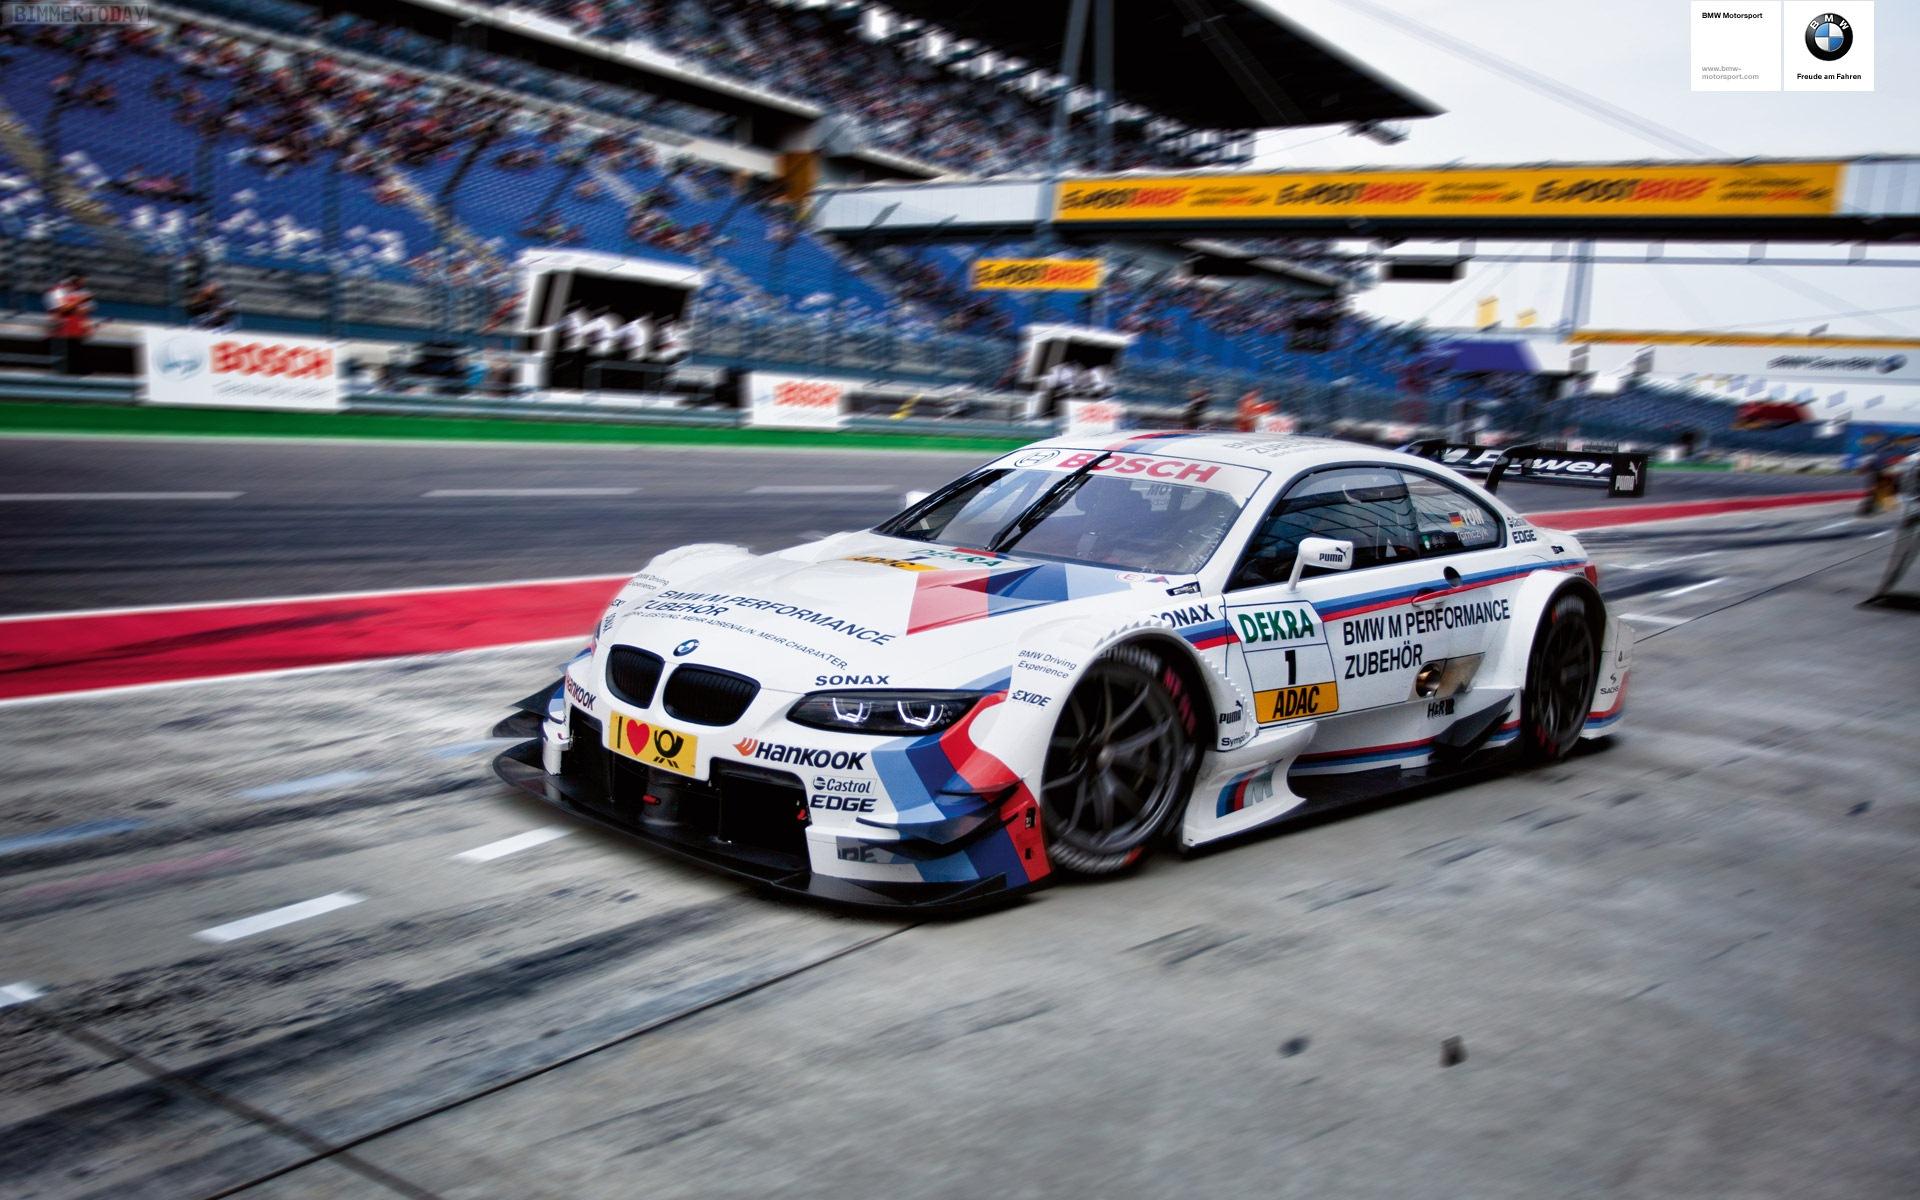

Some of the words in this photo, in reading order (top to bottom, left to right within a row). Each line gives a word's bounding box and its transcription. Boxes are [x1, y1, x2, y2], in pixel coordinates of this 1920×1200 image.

[1056, 452, 1222, 484] BOSCH
[1460, 508, 1485, 526] TOM
[1512, 530, 1537, 544] EDGE
[1319, 553, 1344, 562] PUMA
[658, 590, 703, 600] BMW
[724, 595, 896, 646] PERFORMANCE
[1151, 603, 1215, 628] ONAX
[1238, 608, 1315, 643] DEKRA
[1343, 616, 1385, 646] BMW
[1388, 613, 1401, 639] M
[1404, 599, 1511, 636] PERFORMANCE
[758, 631, 787, 645] MEHR
[785, 641, 848, 671] CHARAKTER.
[1018, 649, 1044, 660] BMW
[1043, 653, 1077, 671] Driving
[1344, 640, 1423, 680] ZUBEHÖR
[1018, 660, 1069, 679] Experience
[1284, 650, 1297, 686] 1
[815, 675, 890, 686] SONAX
[1012, 689, 1052, 707] EXIDE
[1272, 685, 1320, 719] ADAC
[826, 778, 871, 794] Castrol
[810, 794, 878, 813] EDGE
